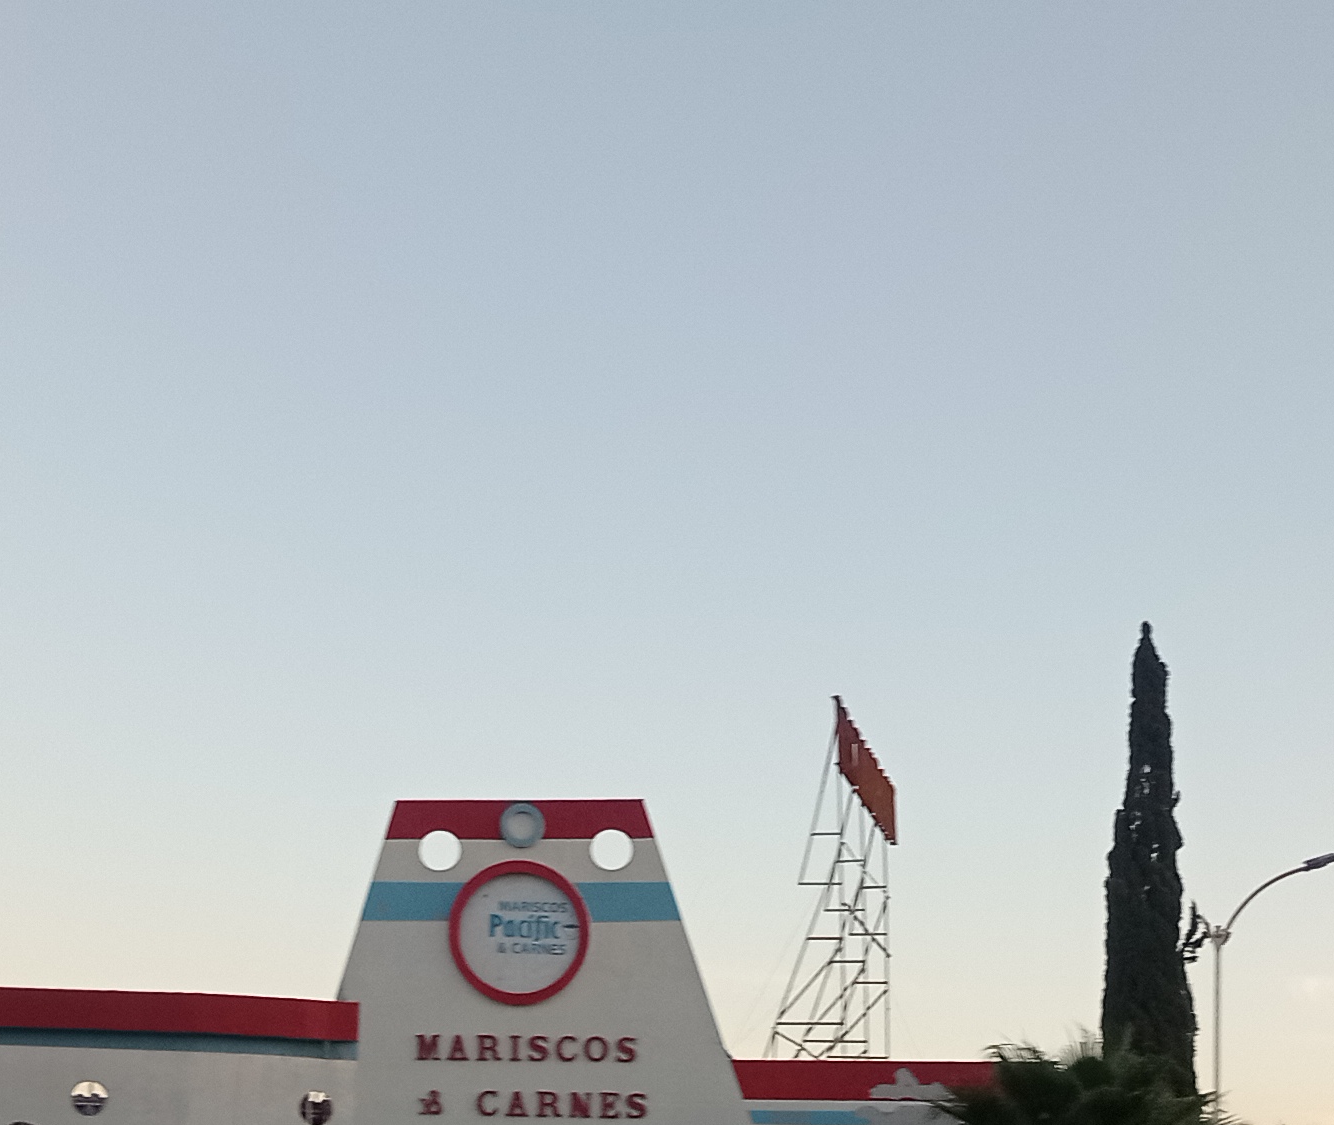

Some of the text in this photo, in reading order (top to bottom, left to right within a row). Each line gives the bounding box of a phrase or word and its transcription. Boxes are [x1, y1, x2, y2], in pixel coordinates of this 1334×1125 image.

[498, 902, 567, 913] MARISCOS
[489, 913, 561, 942] Pacific
[512, 943, 565, 956] CARNES
[415, 1033, 638, 1063] MARISCOS
[475, 1090, 648, 1119] CARNES
